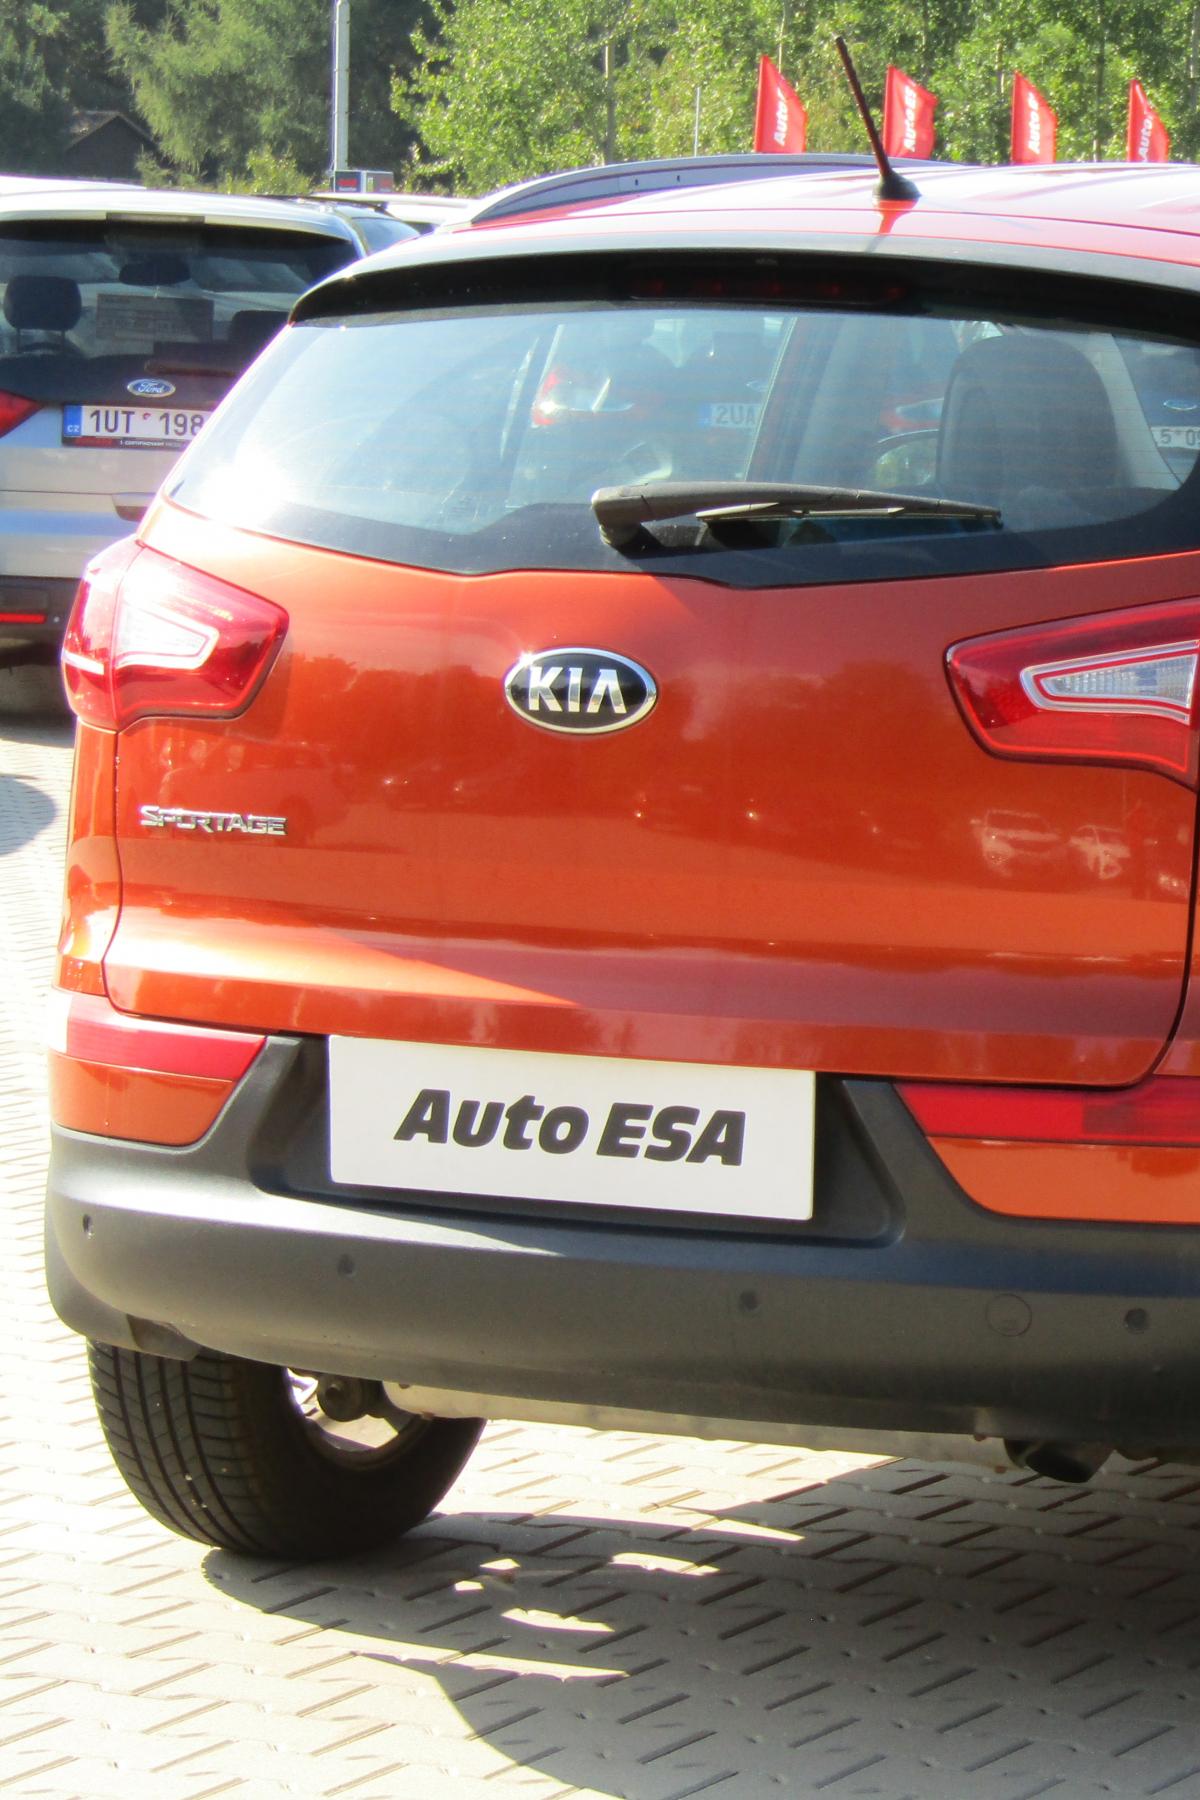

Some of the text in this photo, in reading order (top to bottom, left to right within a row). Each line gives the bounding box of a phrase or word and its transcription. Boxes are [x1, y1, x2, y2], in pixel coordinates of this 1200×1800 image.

[773, 102, 788, 147] Auto
[903, 111, 918, 152] Auto
[1028, 110, 1041, 155] Auto
[1138, 117, 1153, 162] Auto
[138, 381, 164, 394] Ford
[90, 409, 135, 434] 1UT
[528, 666, 627, 714] KIA
[140, 805, 287, 836] SPORTAGE
[393, 1088, 747, 1167] Auto ESA
